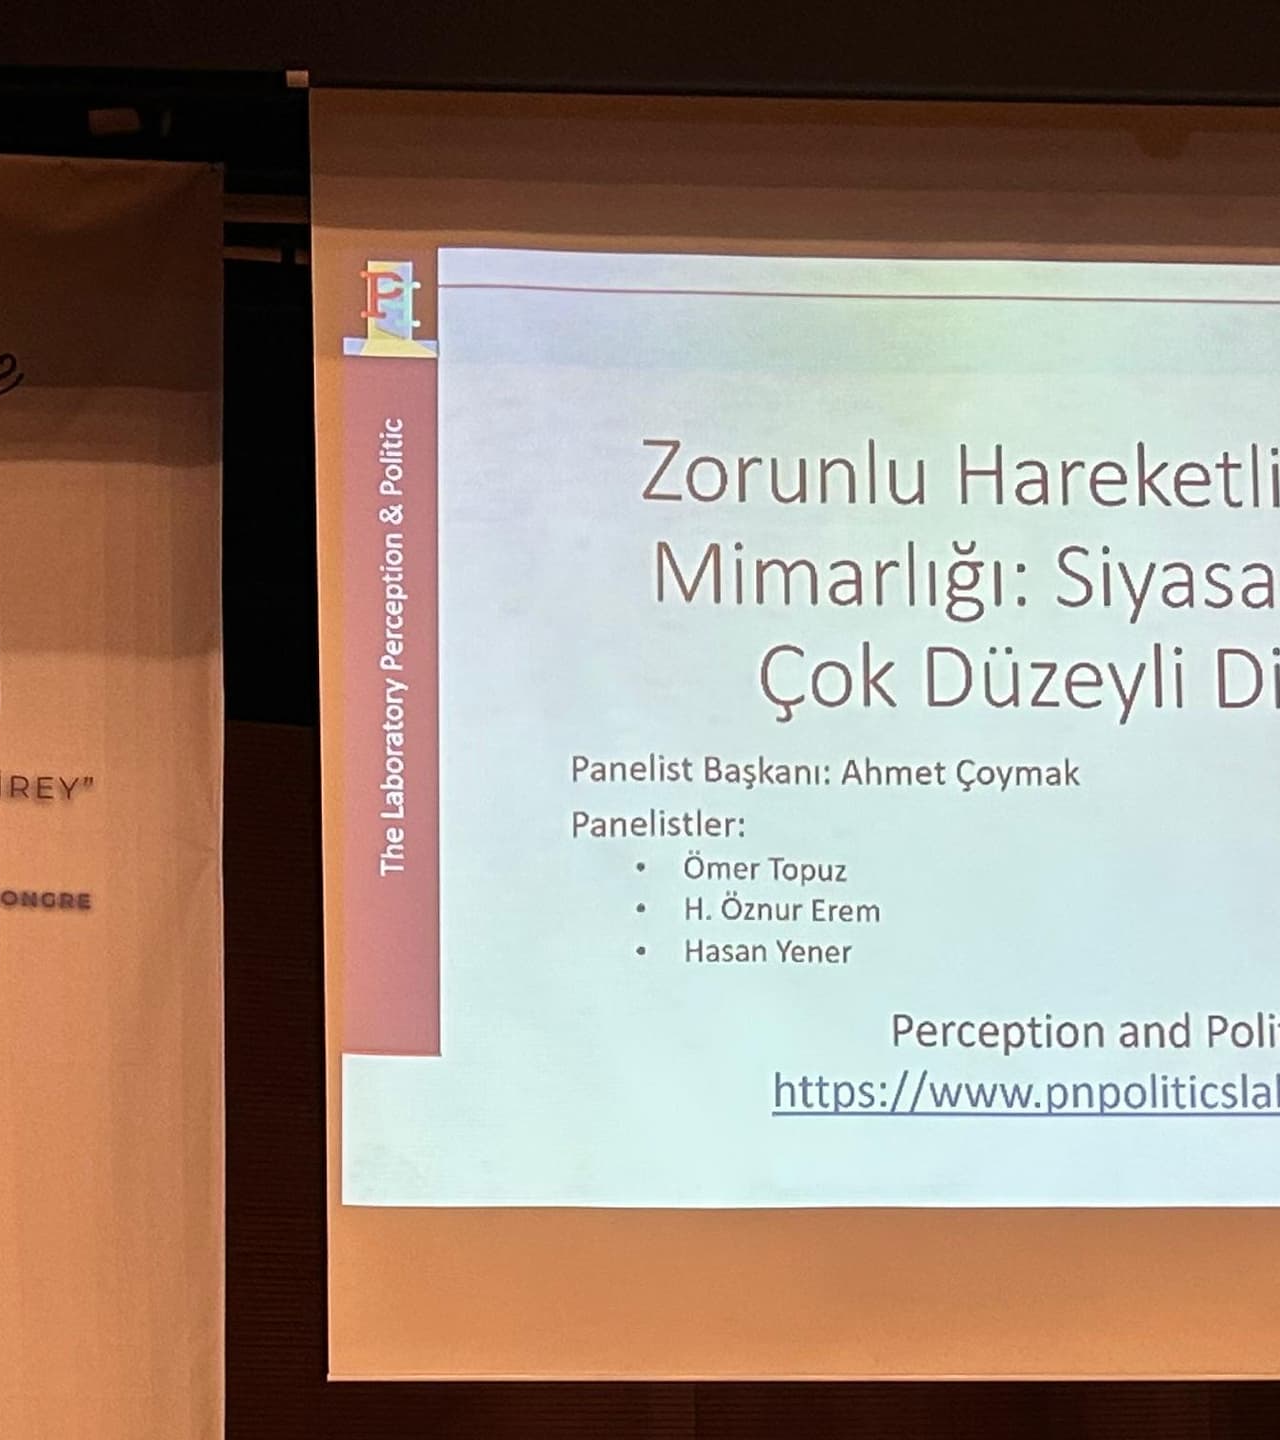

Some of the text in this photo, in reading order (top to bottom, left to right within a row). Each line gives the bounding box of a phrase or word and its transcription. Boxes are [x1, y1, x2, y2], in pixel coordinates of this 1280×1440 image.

[642, 438, 925, 505] Zorunlu
[656, 540, 1028, 623] Mimarlığı:
[379, 418, 408, 877] The Laboratory Perception & Politic
[761, 641, 897, 723] Çok
[927, 643, 1183, 725] Düzeyli
[572, 753, 1080, 793] Panelist Başkanı: Ahmet Çoymak
[572, 809, 746, 839] Panelistler:
[683, 850, 847, 886] Ömer Topuz
[685, 891, 881, 923] H. Öznur Erem
[685, 940, 852, 965] Hasan Yener
[892, 1013, 1105, 1056] Perception
[1119, 1013, 1191, 1049] and
